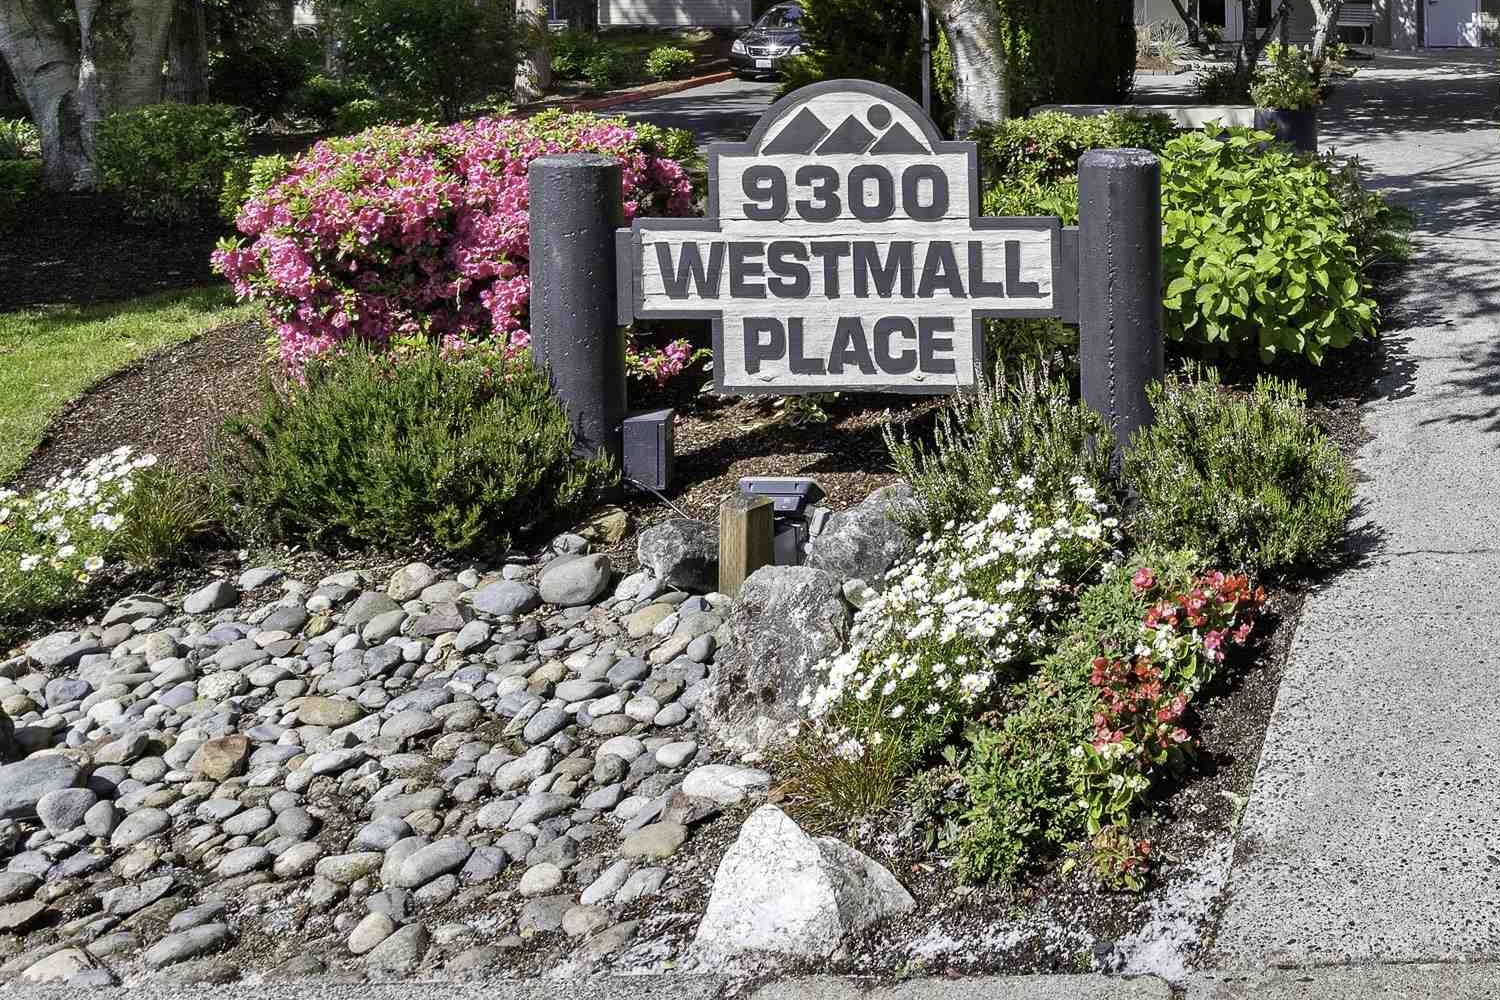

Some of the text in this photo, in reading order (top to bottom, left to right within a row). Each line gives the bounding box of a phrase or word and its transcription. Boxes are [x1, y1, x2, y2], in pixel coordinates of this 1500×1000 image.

[742, 164, 950, 223] 9300
[655, 240, 1050, 300] WESTMALL
[742, 315, 956, 376] PLACE
